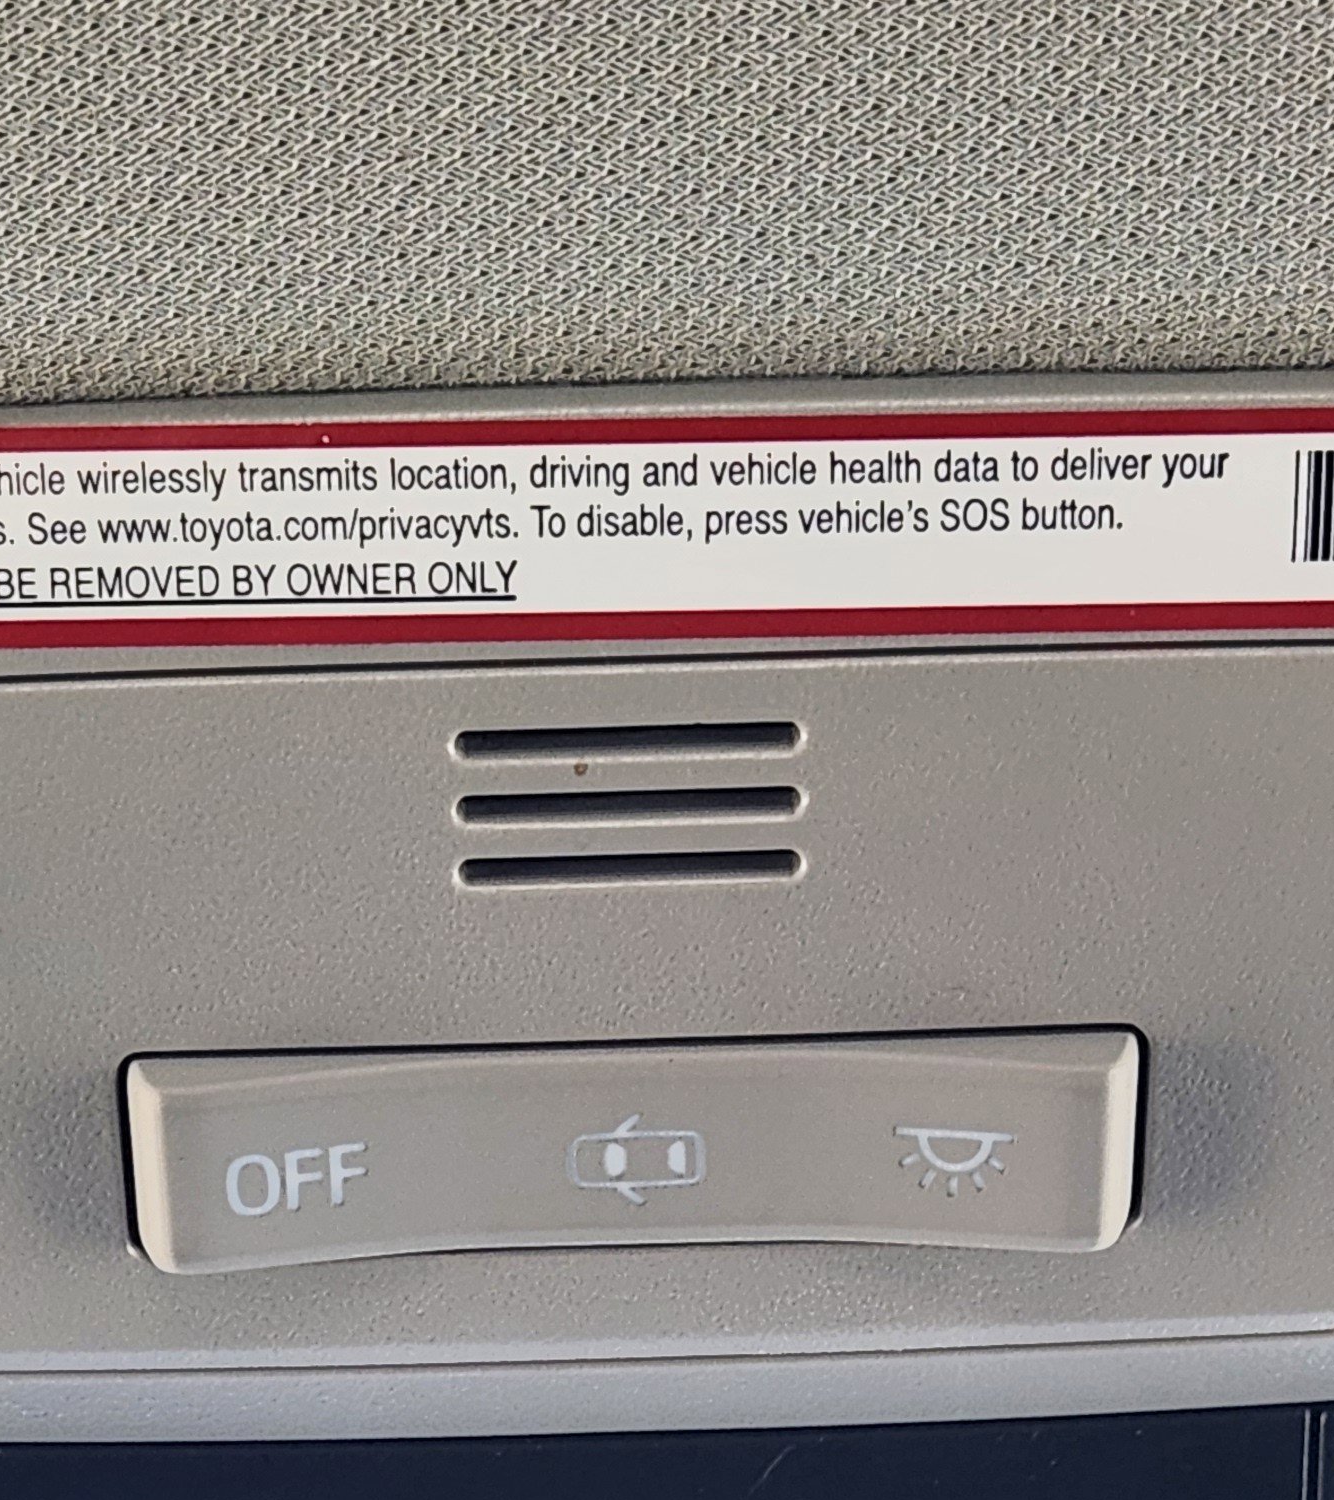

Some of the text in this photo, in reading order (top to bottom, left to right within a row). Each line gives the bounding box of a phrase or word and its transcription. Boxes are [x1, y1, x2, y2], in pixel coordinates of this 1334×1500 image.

[77, 461, 226, 501] wirelessly
[238, 459, 377, 492] transmits
[390, 457, 516, 494] location,
[530, 455, 629, 496] driving
[643, 453, 697, 486] and
[710, 452, 816, 485] vehicle
[830, 451, 920, 484] health
[935, 450, 999, 482] data
[1011, 451, 1038, 481] to
[1051, 447, 1152, 481] deliver
[1162, 453, 1229, 488] your
[29, 513, 86, 544] See
[98, 508, 518, 550] www.toyota.com/privacyvts.
[530, 505, 565, 537] To
[578, 504, 692, 541] disable,
[706, 510, 787, 544] press
[798, 500, 928, 533] vehicle's
[941, 498, 1009, 532] SOS
[1022, 498, 1122, 530] button.
[50, 566, 219, 598] REMOVED
[233, 565, 276, 596] BY
[287, 563, 416, 596] OWNER
[429, 560, 517, 594] ONLY
[224, 1141, 370, 1217] OFF
